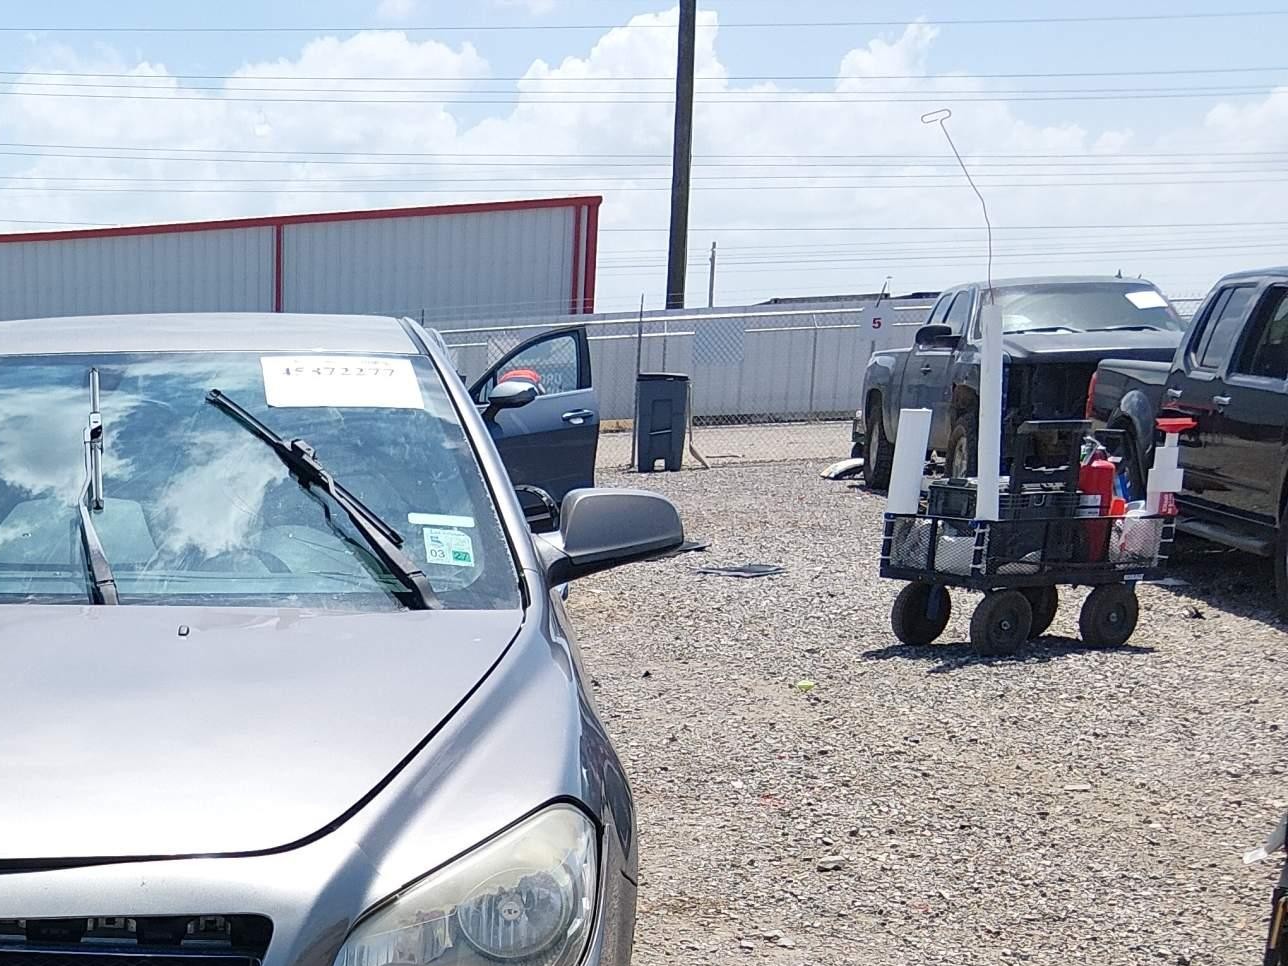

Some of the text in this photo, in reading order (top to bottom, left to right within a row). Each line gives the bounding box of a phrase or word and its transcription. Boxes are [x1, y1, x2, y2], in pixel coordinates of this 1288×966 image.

[872, 317, 882, 329] 5
[430, 549, 468, 561] 03 27
